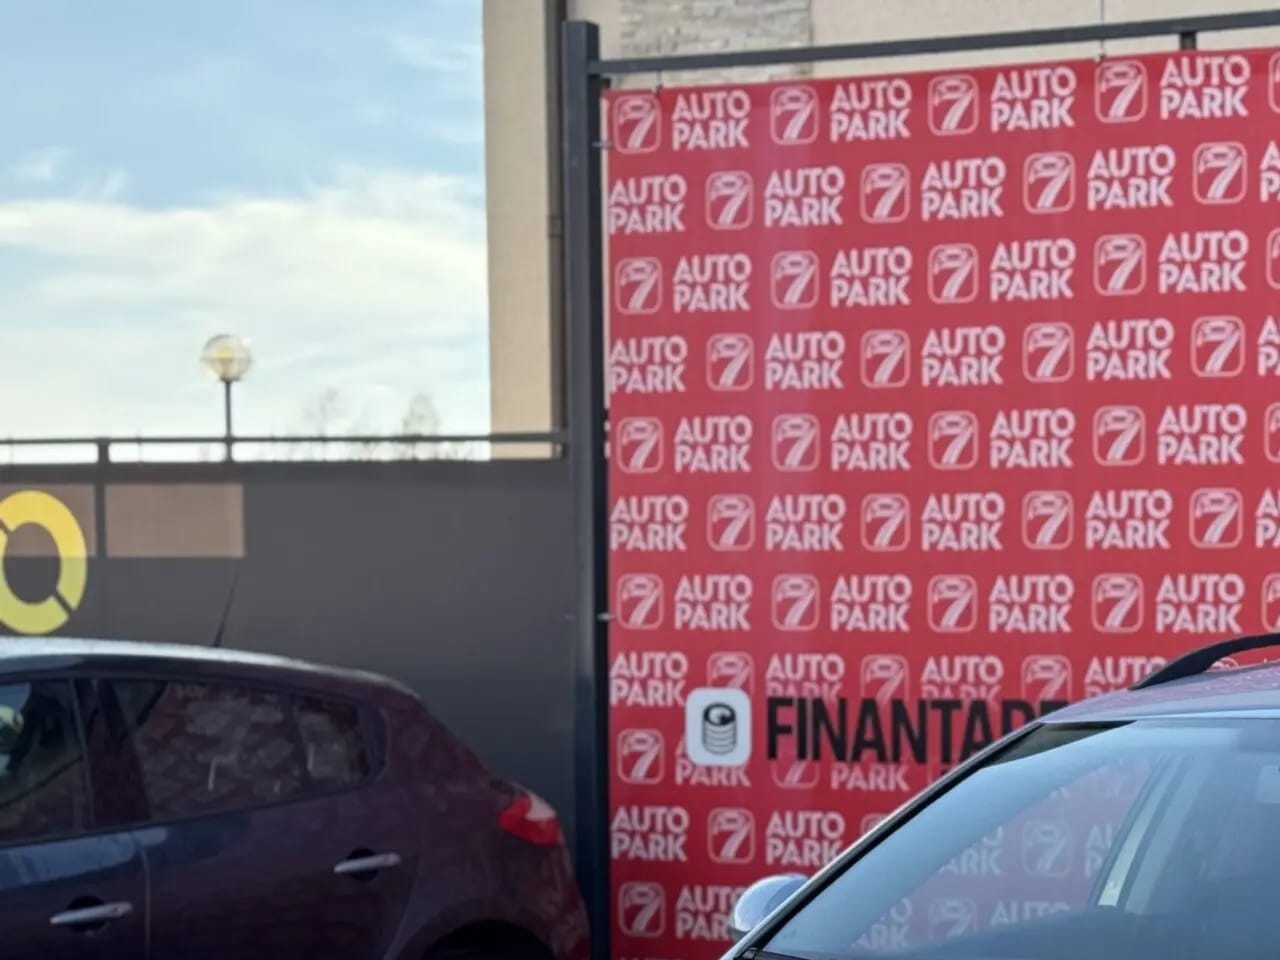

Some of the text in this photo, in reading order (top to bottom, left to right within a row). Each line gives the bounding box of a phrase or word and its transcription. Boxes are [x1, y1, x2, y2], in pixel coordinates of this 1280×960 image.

[992, 69, 1075, 100] AUTO
[1161, 57, 1248, 86] AUTO
[674, 93, 748, 119] AUTO
[832, 82, 910, 110] AUTO
[1161, 86, 1248, 118] PARK
[831, 109, 909, 141] PARK
[992, 97, 1074, 131] PARK
[673, 119, 748, 149] PARK
[921, 157, 1005, 191] AUTO
[1088, 146, 1175, 180] AUTO
[611, 173, 686, 203] AUTO
[765, 167, 844, 199] AUTO
[1088, 175, 1172, 209] PARK
[765, 195, 842, 225] PARK
[922, 186, 1002, 219] PARK
[611, 203, 685, 234] PARK
[990, 239, 1076, 272] AUTO
[1159, 230, 1248, 264] AUTO
[673, 254, 751, 284] AUTO
[831, 247, 912, 277] AUTO
[1159, 260, 1246, 292] PARK
[674, 281, 748, 310] PARK
[832, 276, 909, 305] PARK
[991, 268, 1072, 300] PARK
[611, 334, 687, 364] AUTO
[765, 332, 844, 361] AUTO
[922, 326, 1005, 357] AUTO
[1087, 319, 1174, 350] AUTO
[766, 359, 842, 388] PARK
[922, 354, 1002, 385] PARK
[1087, 348, 1171, 379] PARK
[611, 364, 684, 393] PARK
[675, 416, 752, 444] AUTO
[831, 413, 912, 442] AUTO
[990, 408, 1075, 439] AUTO
[1157, 404, 1247, 435] AUTO
[676, 443, 749, 471] PARK
[832, 440, 910, 469] PARK
[991, 437, 1072, 467] PARK
[1158, 433, 1244, 464] PARK
[610, 496, 688, 524] AUTO
[766, 495, 845, 522] AUTO
[922, 493, 1004, 522] AUTO
[1085, 490, 1172, 520] AUTO
[610, 522, 686, 550] PARK
[767, 522, 842, 549] PARK
[922, 521, 1002, 549] PARK
[1086, 518, 1169, 548] PARK
[675, 575, 752, 603] AUTO
[831, 575, 912, 603] AUTO
[989, 575, 1074, 604] AUTO
[1156, 574, 1244, 604] AUTO
[676, 601, 749, 629] PARK
[832, 602, 909, 630] PARK
[990, 603, 1070, 632] PARK
[1157, 603, 1241, 632] PARK
[610, 653, 686, 679] AUTO
[767, 654, 844, 681] AUTO
[922, 656, 1003, 684] AUTO
[610, 678, 683, 705] PARK
[832, 764, 908, 790] PARK
[611, 807, 688, 833] AUTO
[767, 812, 844, 838] AUTO
[612, 832, 686, 860] PARK
